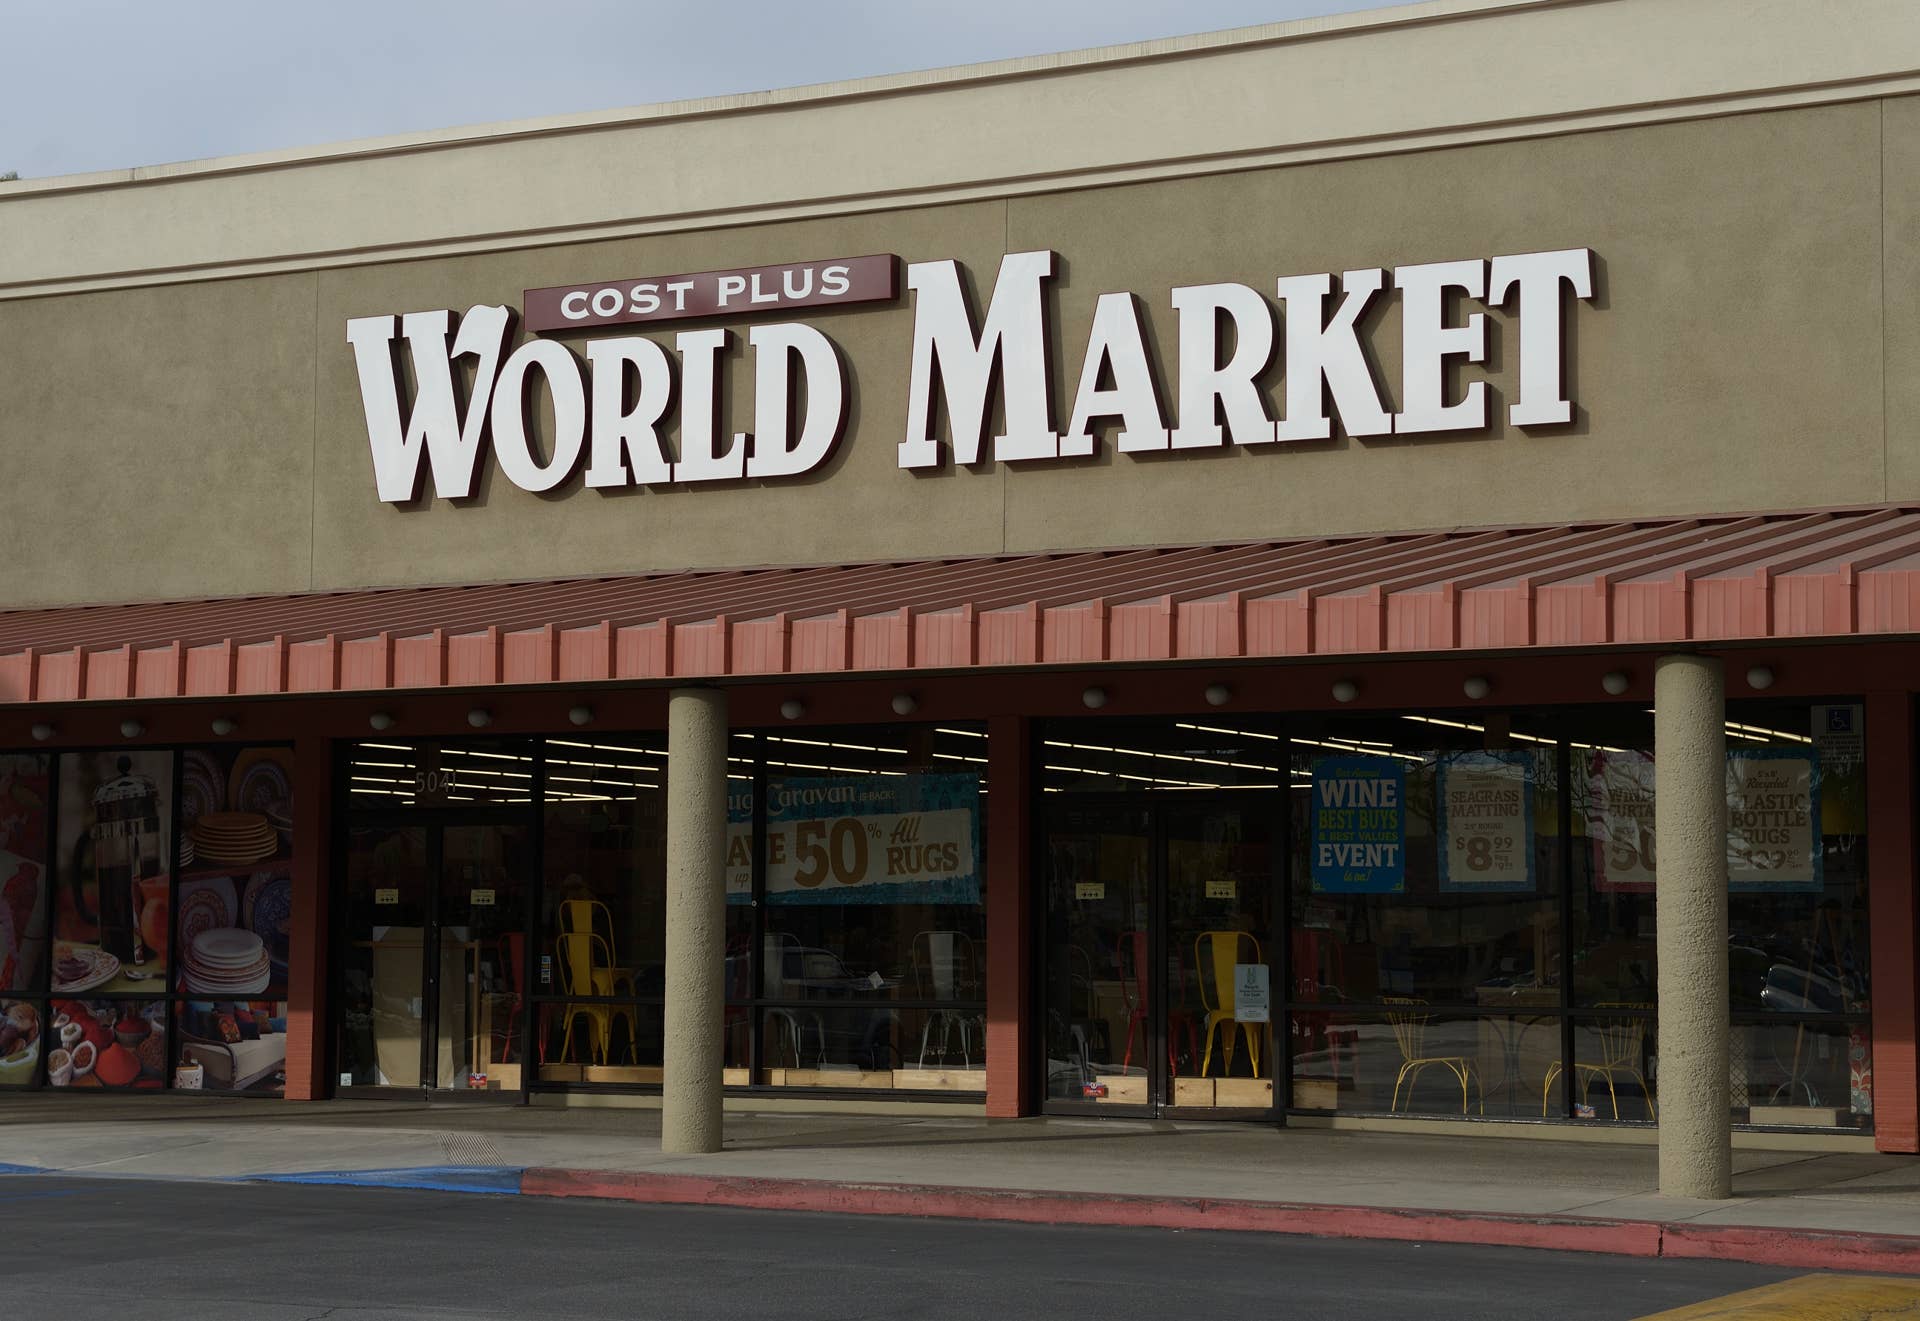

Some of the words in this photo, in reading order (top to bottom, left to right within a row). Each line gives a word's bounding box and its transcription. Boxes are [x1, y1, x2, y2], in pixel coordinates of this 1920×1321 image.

[560, 280, 694, 320] COST
[717, 266, 850, 307] PLUS
[416, 771, 456, 793] 5041
[1318, 779, 1397, 808] WINE
[1451, 789, 1519, 803] SEAGRASS
[1741, 794, 1808, 810] LASTIC
[1318, 808, 1355, 830] BEST
[1359, 808, 1398, 830] BUYS
[1451, 803, 1519, 818] MATTING
[1731, 810, 1807, 828] BOTTLE
[889, 816, 922, 845] All
[1330, 832, 1355, 841] BEST
[1358, 832, 1398, 841] VALUES
[1743, 828, 1791, 845] RUGS
[886, 842, 960, 876] RUGS
[1318, 843, 1399, 868] EVENT
[735, 872, 750, 888] up
